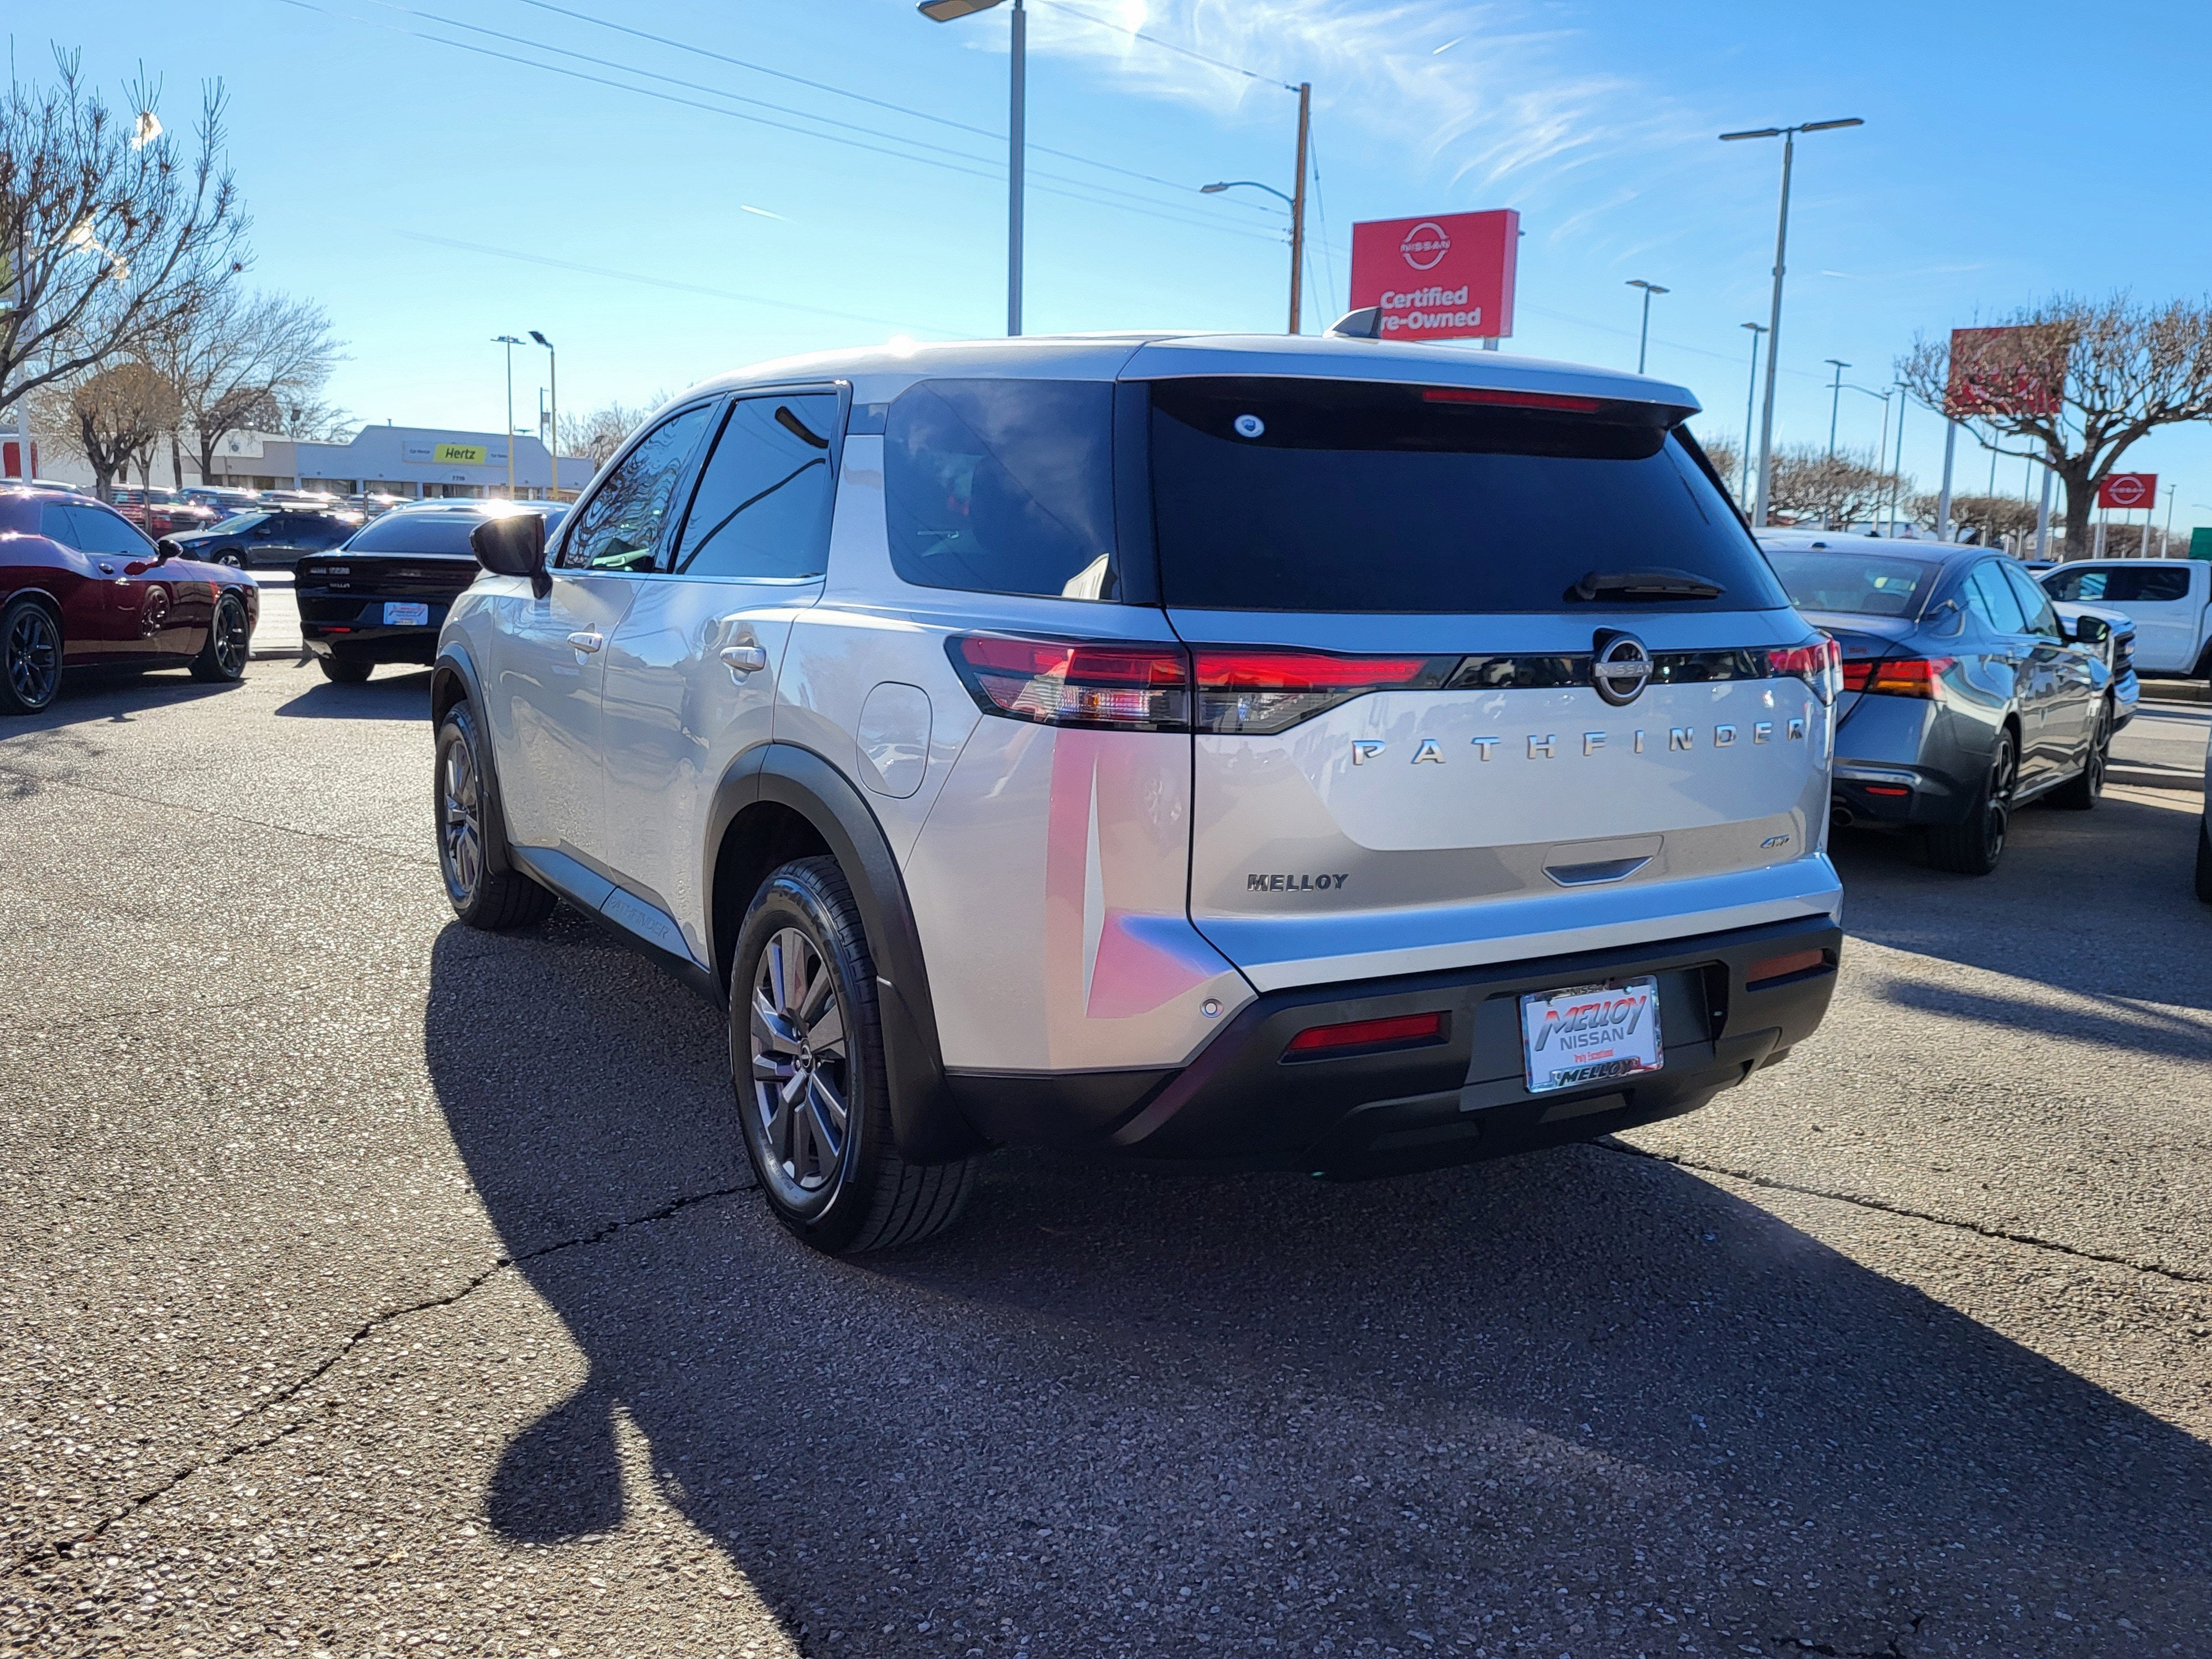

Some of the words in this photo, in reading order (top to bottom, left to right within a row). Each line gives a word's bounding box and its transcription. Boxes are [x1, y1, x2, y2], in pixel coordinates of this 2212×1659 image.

[1400, 239, 1451, 253] NISSAN
[1380, 285, 1468, 309] Certified
[1381, 307, 1481, 330] re-Owned
[445, 447, 476, 460] Hertz
[1352, 718, 1803, 766] PATHFINDER
[1247, 874, 1349, 891] MELLOY
[1534, 995, 1647, 1051] MELLOY
[1560, 1027, 1624, 1051] NISSAN
